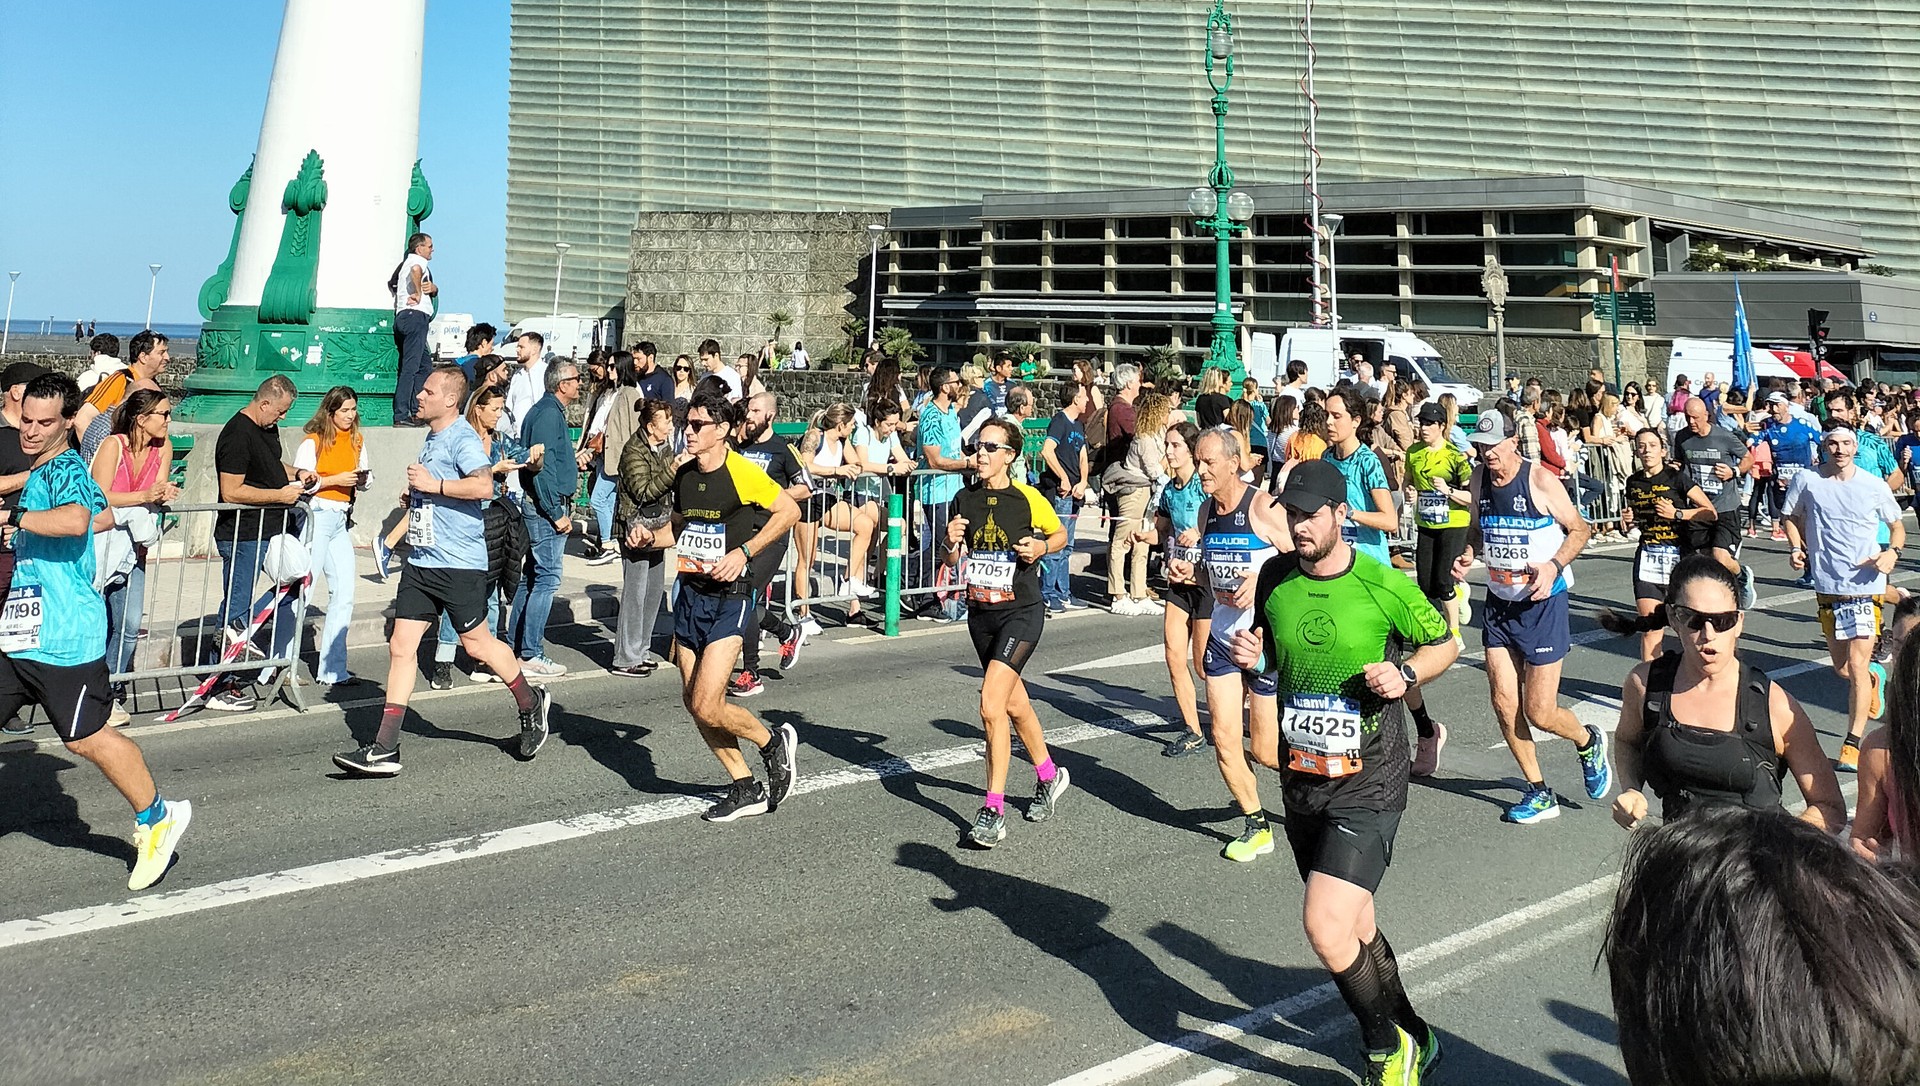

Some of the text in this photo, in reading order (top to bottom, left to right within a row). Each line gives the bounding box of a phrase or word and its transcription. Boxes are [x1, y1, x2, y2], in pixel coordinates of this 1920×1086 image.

[444, 326, 460, 335] pixel
[1420, 498, 1446, 507] 12297
[680, 533, 722, 549] 17050
[1487, 546, 1529, 560] 13268
[969, 562, 1011, 577] 17051
[1288, 713, 1356, 738] 14525
[1346, 749, 1360, 760] 11
